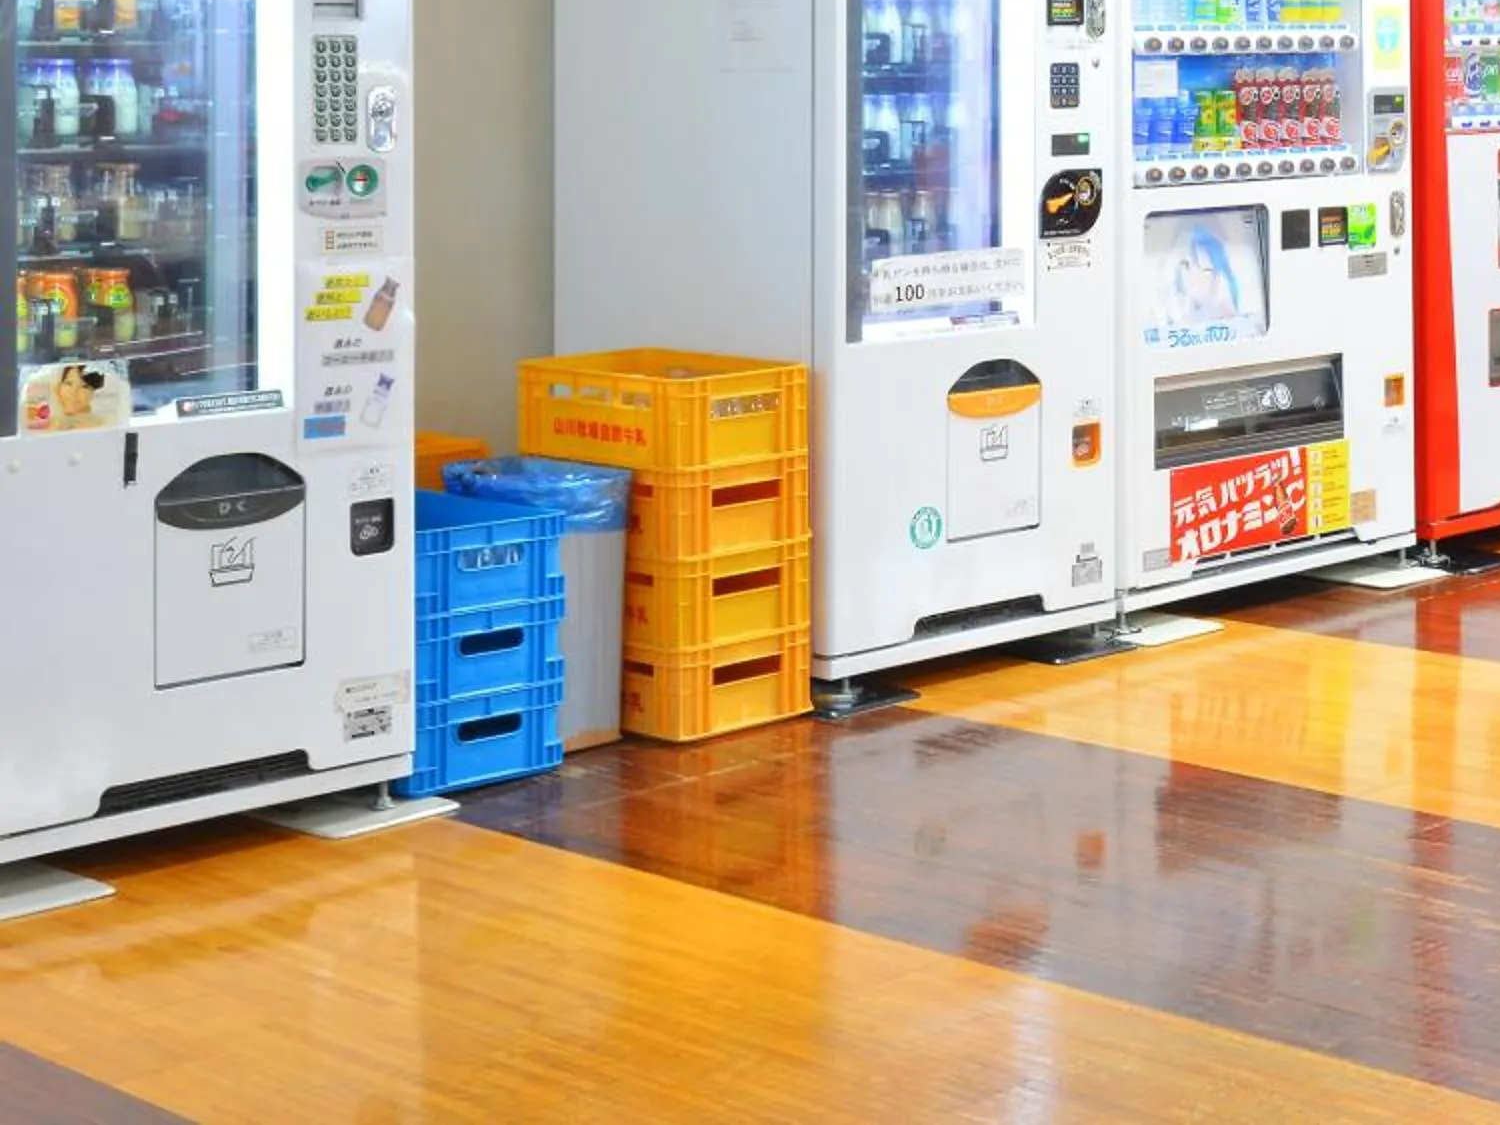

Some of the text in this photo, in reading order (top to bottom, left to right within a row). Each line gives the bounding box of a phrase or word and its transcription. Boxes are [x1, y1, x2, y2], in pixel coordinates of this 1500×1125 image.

[895, 284, 926, 303] 100
[1173, 448, 1301, 528] 元気ハツラツ!
[1177, 478, 1306, 562] オロナミンC
